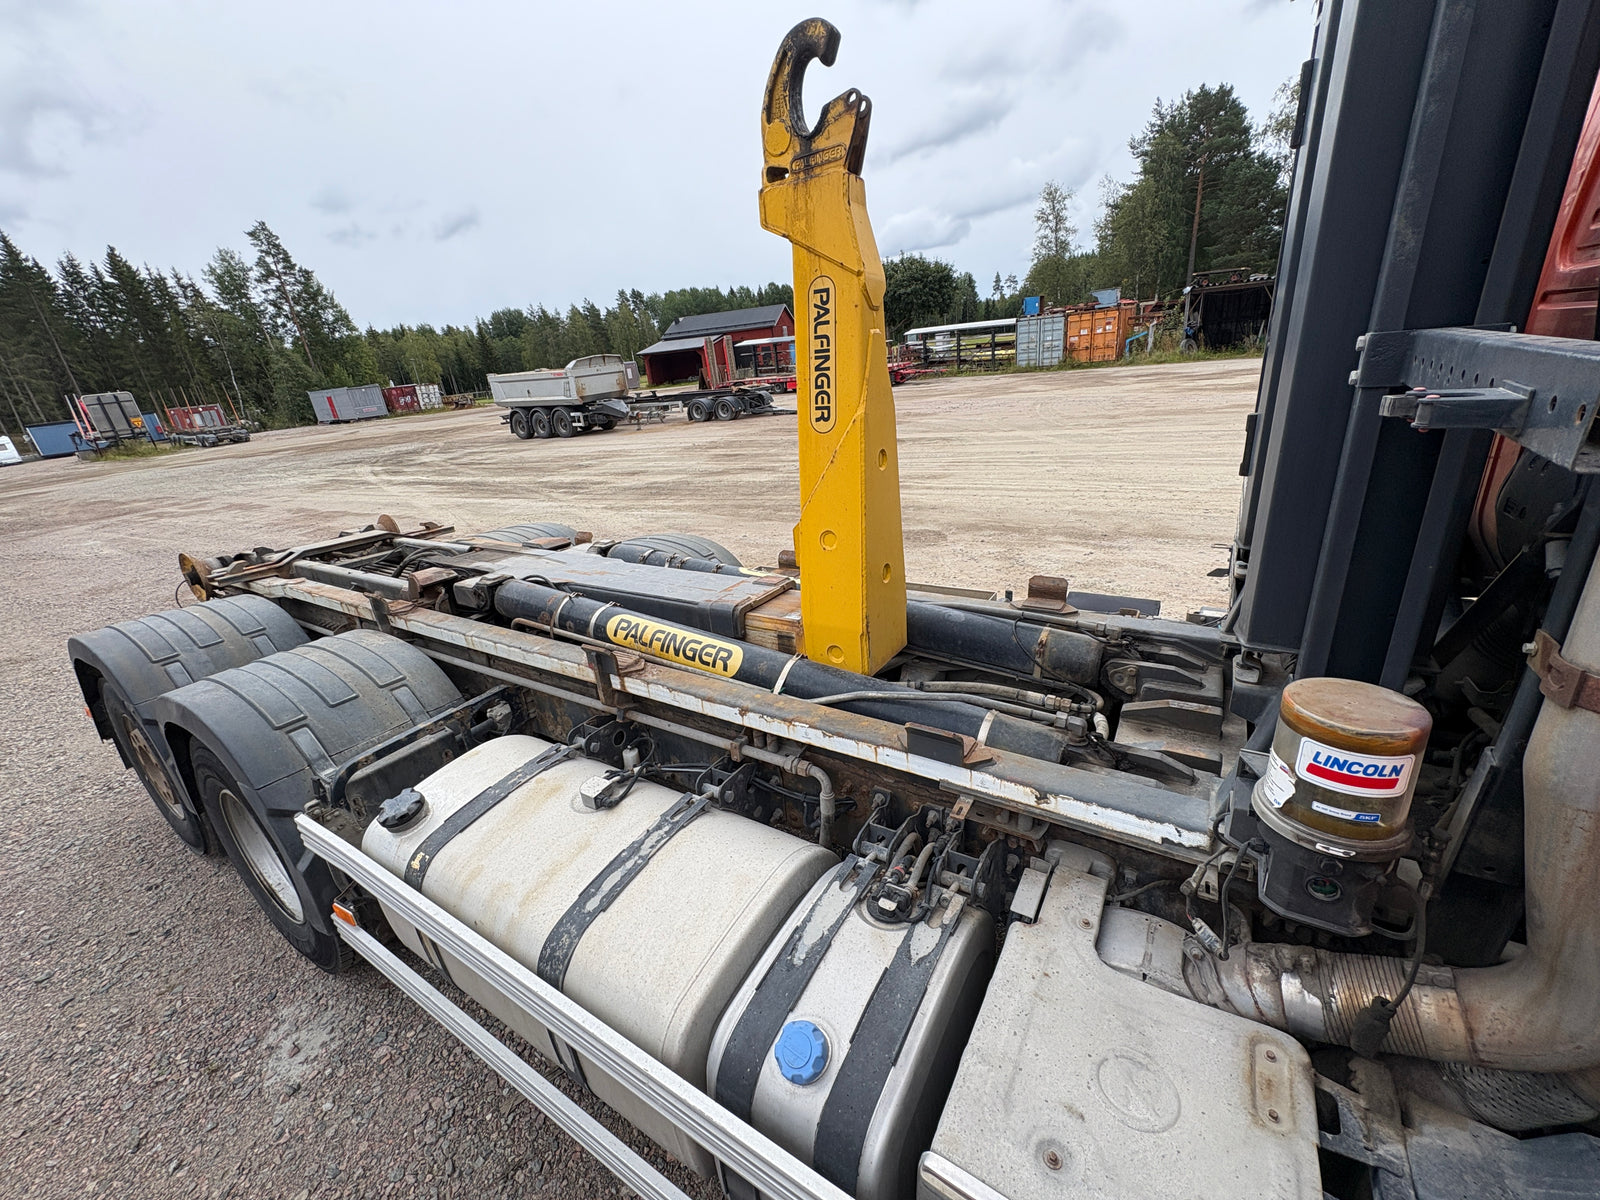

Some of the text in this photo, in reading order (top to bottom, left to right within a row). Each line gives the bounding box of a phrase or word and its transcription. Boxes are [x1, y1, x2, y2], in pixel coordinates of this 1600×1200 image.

[813, 287, 831, 423] PALFINGER
[613, 618, 733, 672] PALFINGER
[1312, 751, 1405, 777] LINCOLN
